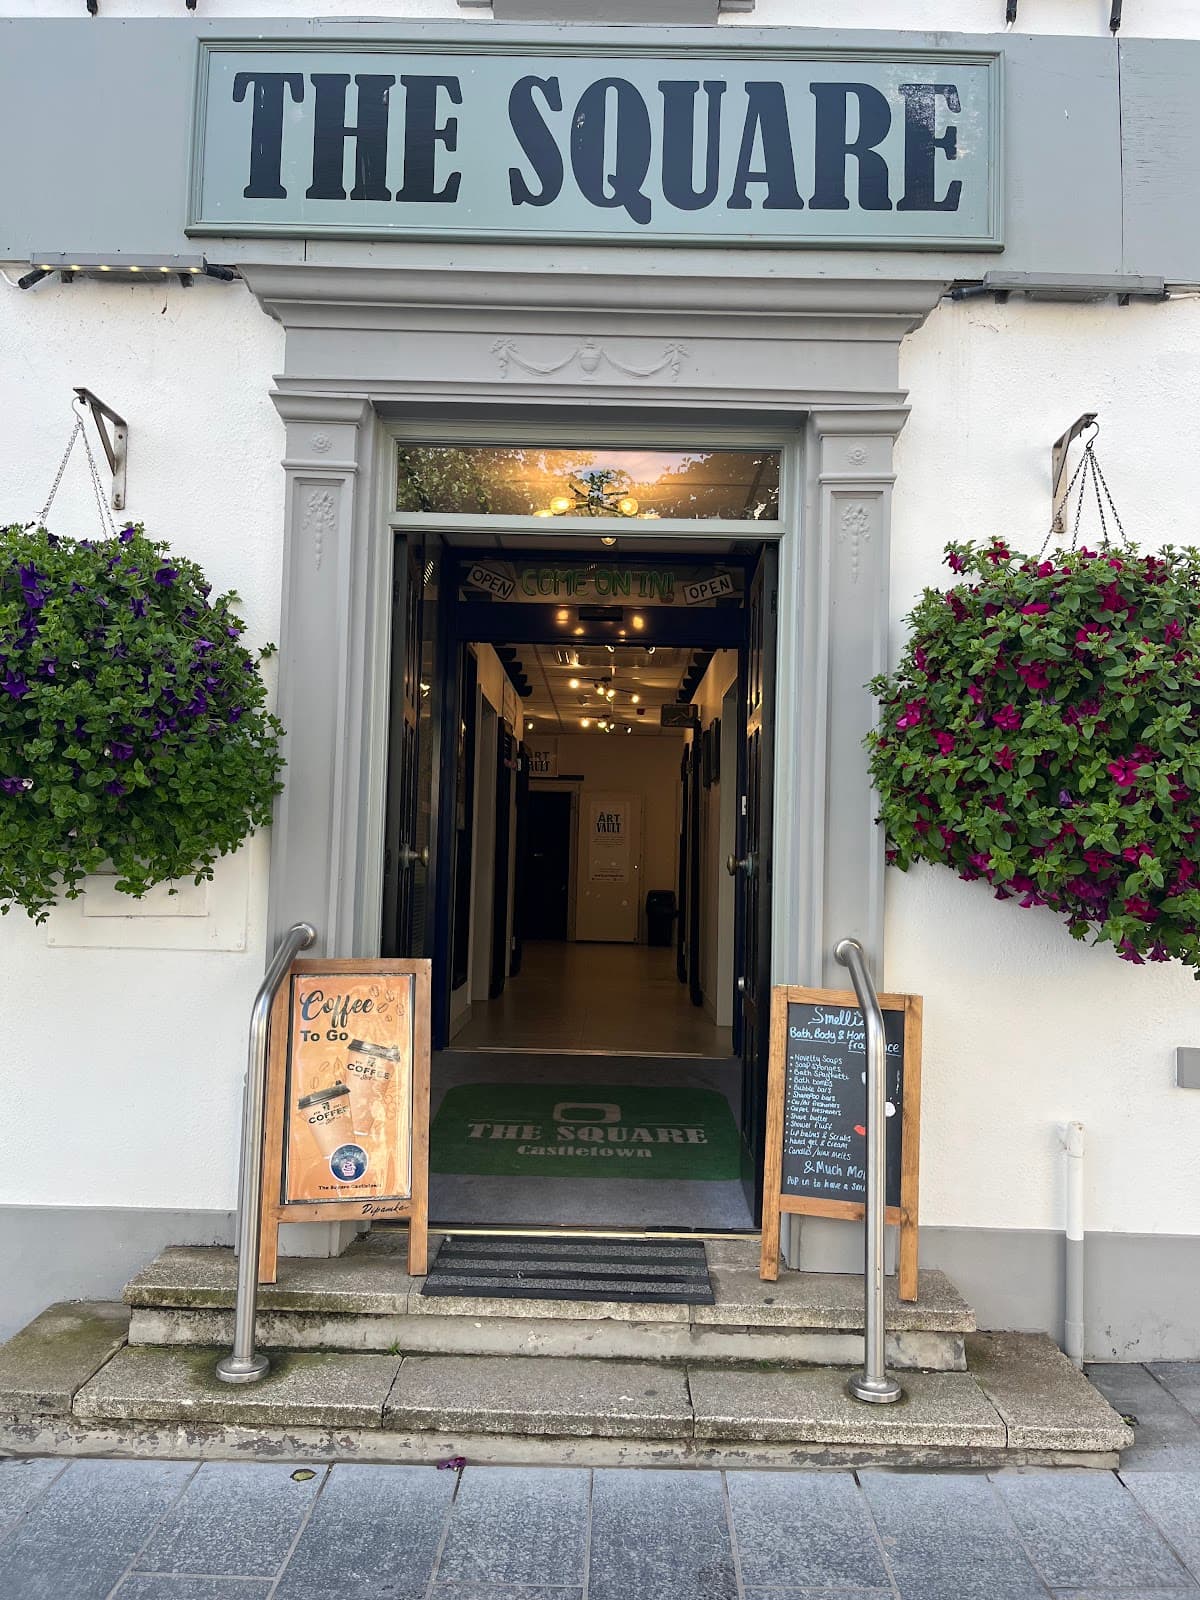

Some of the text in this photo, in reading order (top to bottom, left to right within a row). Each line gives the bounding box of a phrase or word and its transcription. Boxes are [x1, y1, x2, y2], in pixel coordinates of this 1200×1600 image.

[231, 71, 963, 225] THE SQUARE
[471, 568, 513, 597] OPEN
[521, 568, 588, 597] COME
[594, 569, 631, 597] ON
[688, 576, 731, 600] OPEN
[598, 812, 621, 823] ART
[596, 822, 622, 833] VAULT
[300, 990, 374, 1028] Coffee
[300, 1029, 349, 1042] To Go
[789, 1026, 813, 1040] Bath,
[814, 1027, 837, 1044] Body
[846, 1030, 866, 1040] Hom
[794, 1054, 843, 1065] Novelty Soaps
[466, 1122, 708, 1144] THE SQUARE
[516, 1144, 653, 1158] Castletown
[815, 1160, 843, 1177] Much
